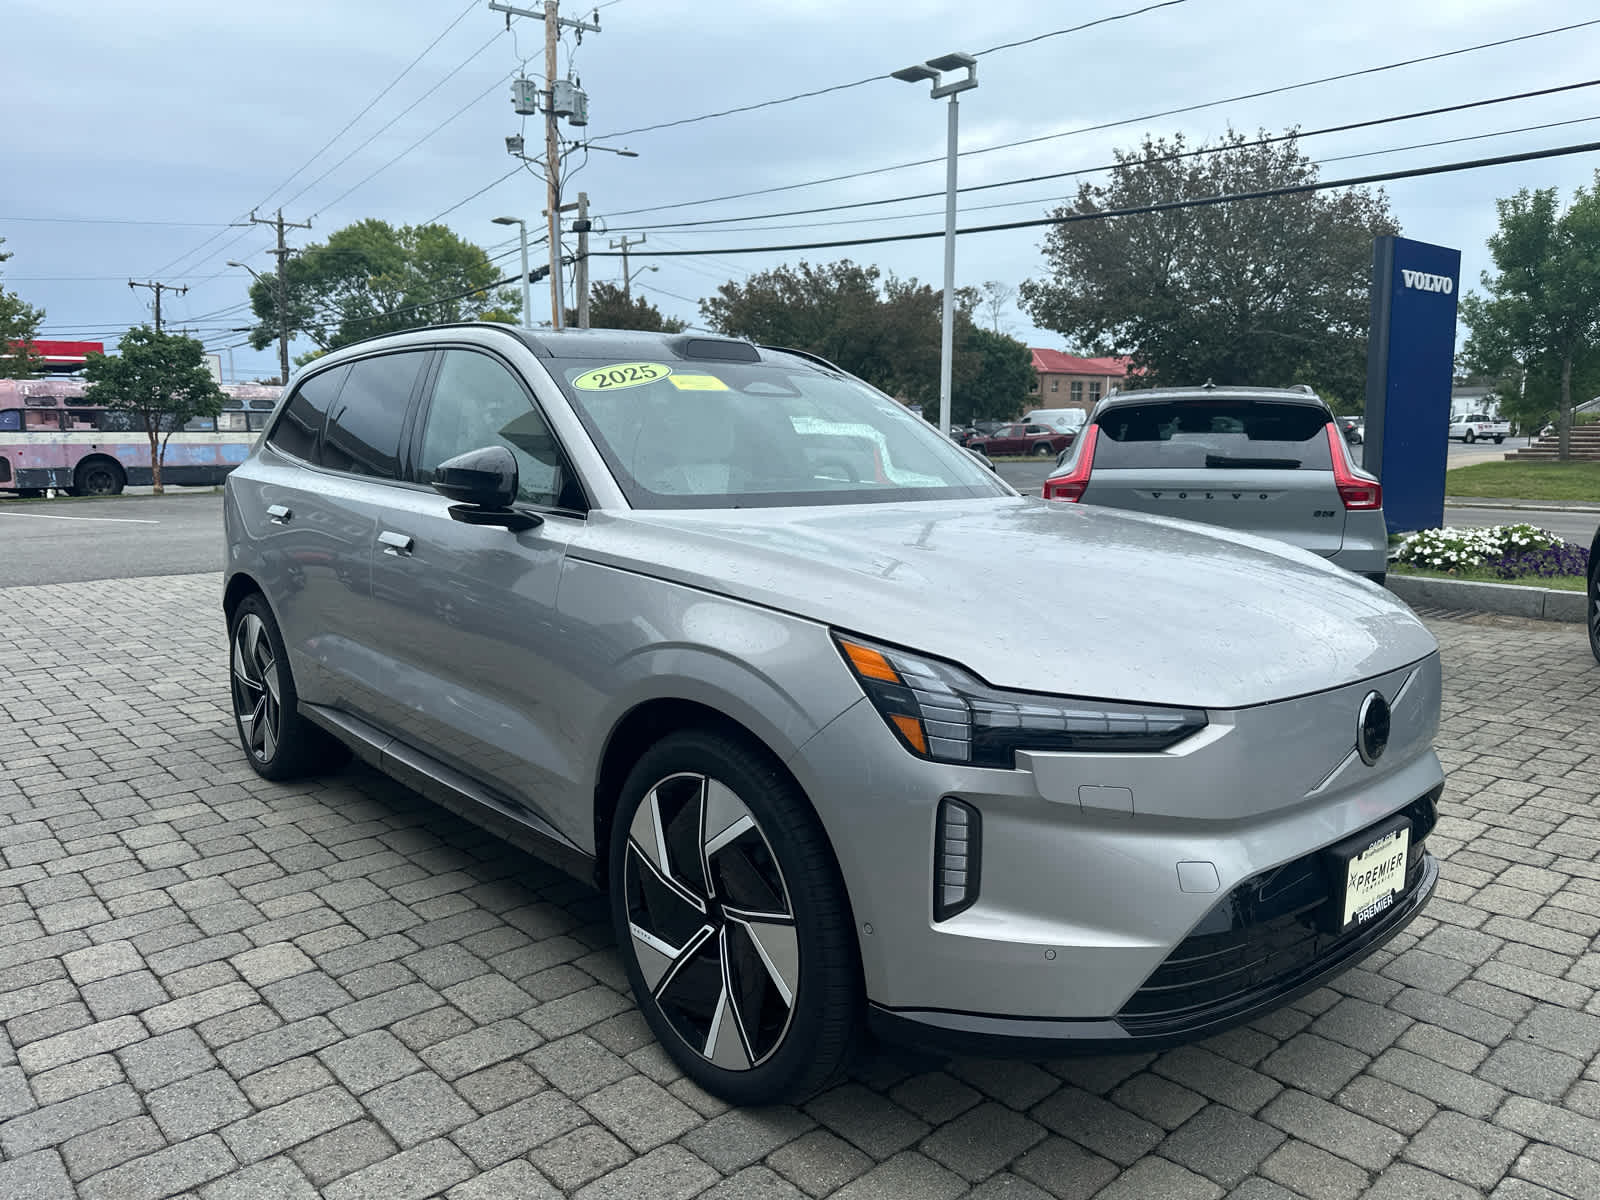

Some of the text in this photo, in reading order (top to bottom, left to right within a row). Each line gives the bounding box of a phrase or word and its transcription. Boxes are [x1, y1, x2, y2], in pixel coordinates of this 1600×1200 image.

[1401, 269, 1453, 295] VOLVO
[592, 365, 657, 388] 2025
[1151, 491, 1268, 500] VOLVO
[1358, 894, 1394, 925] PREMIER
